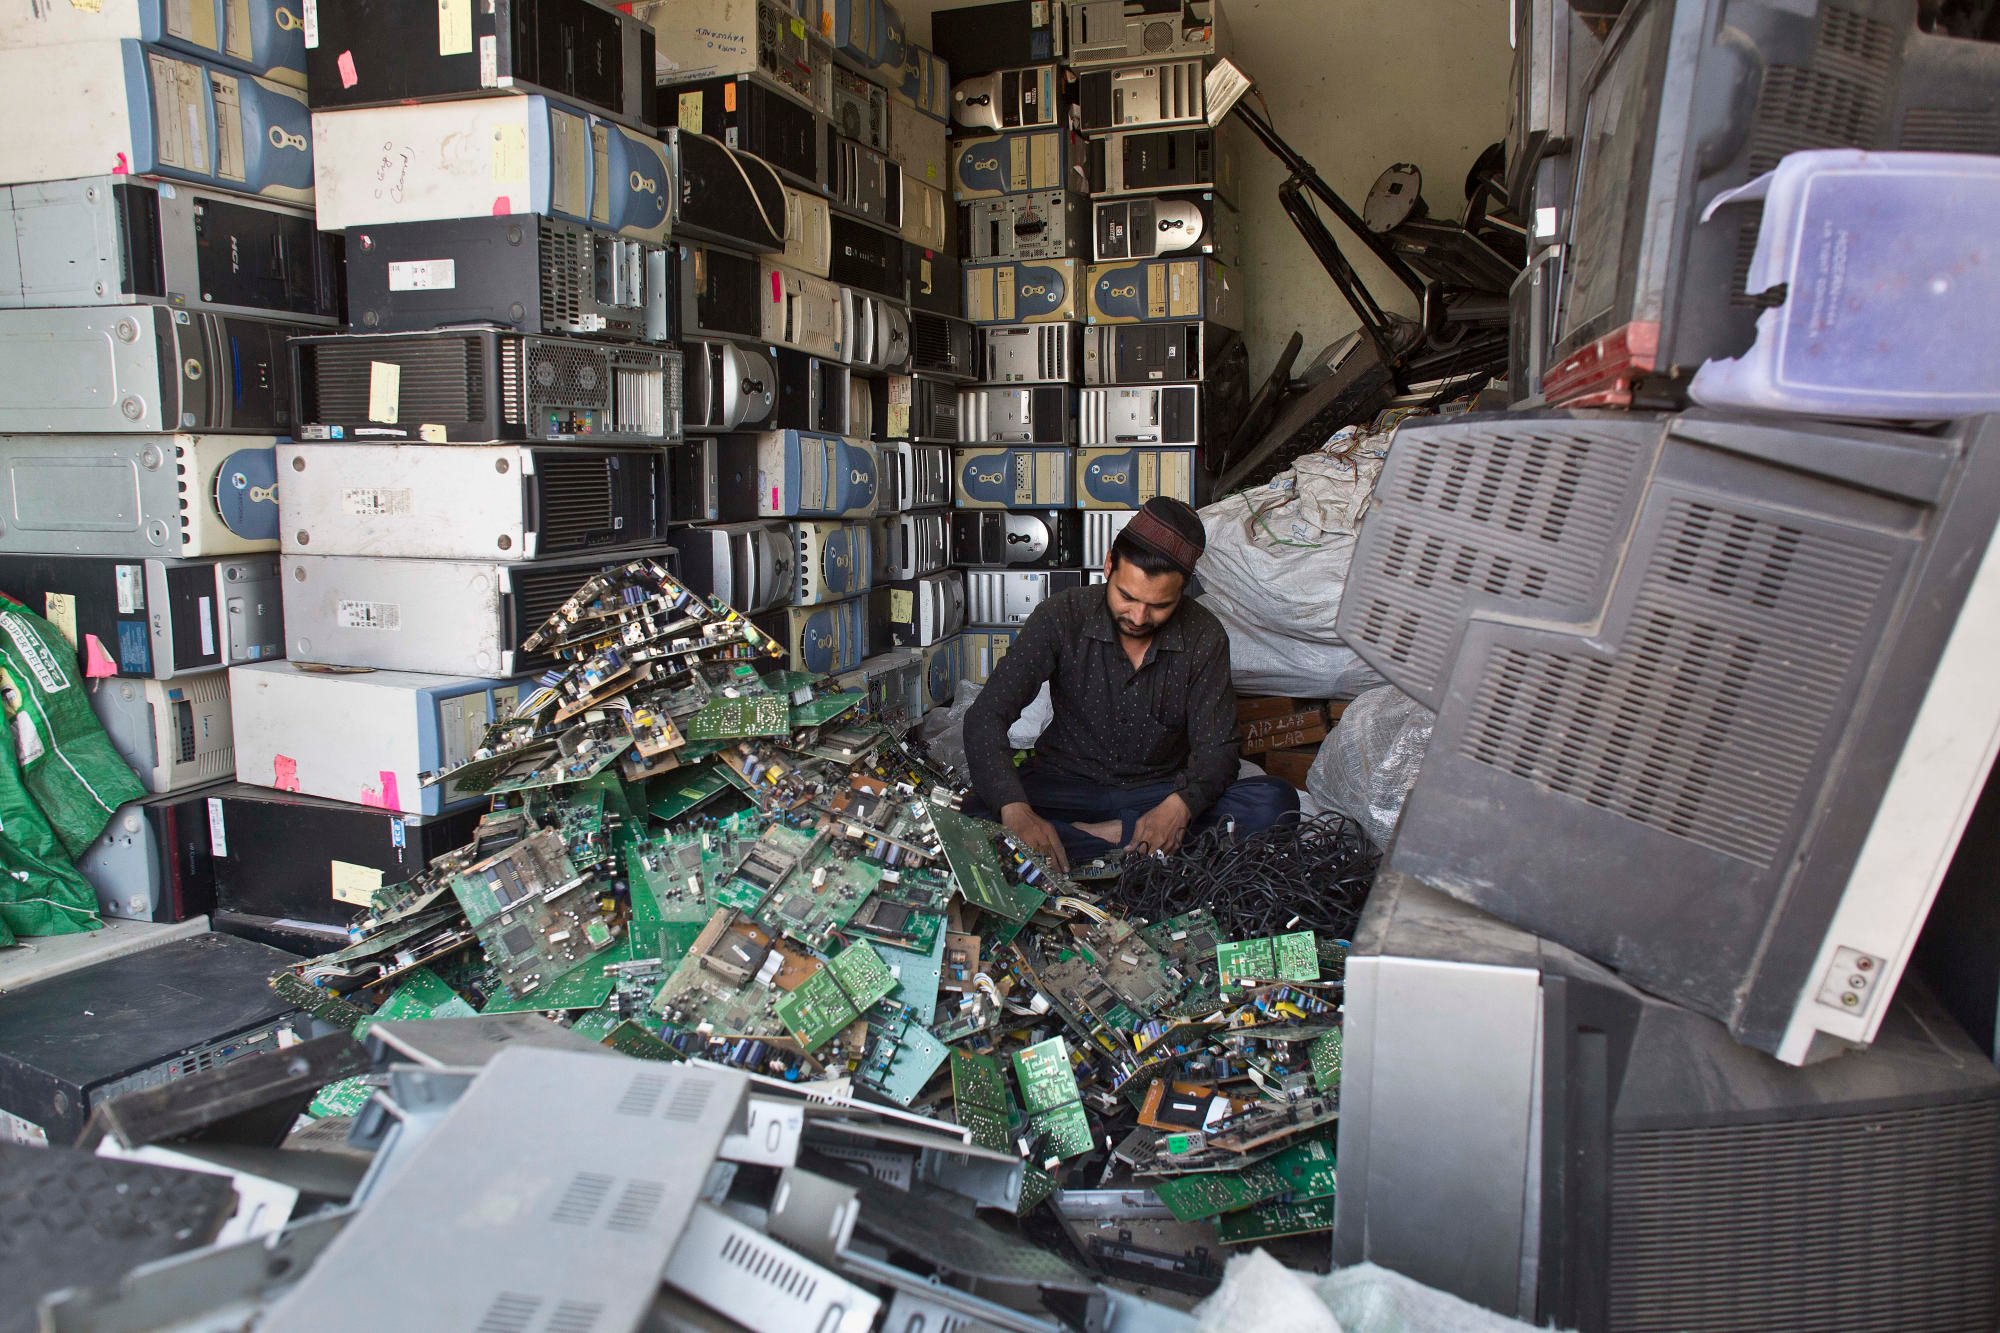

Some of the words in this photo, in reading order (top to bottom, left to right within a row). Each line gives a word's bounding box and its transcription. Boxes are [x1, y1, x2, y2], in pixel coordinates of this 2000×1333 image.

[594, 38, 603, 77] HCL
[231, 234, 240, 275] HCL
[1, 618, 28, 649] SUPER
[25, 649, 55, 688] PELLET
